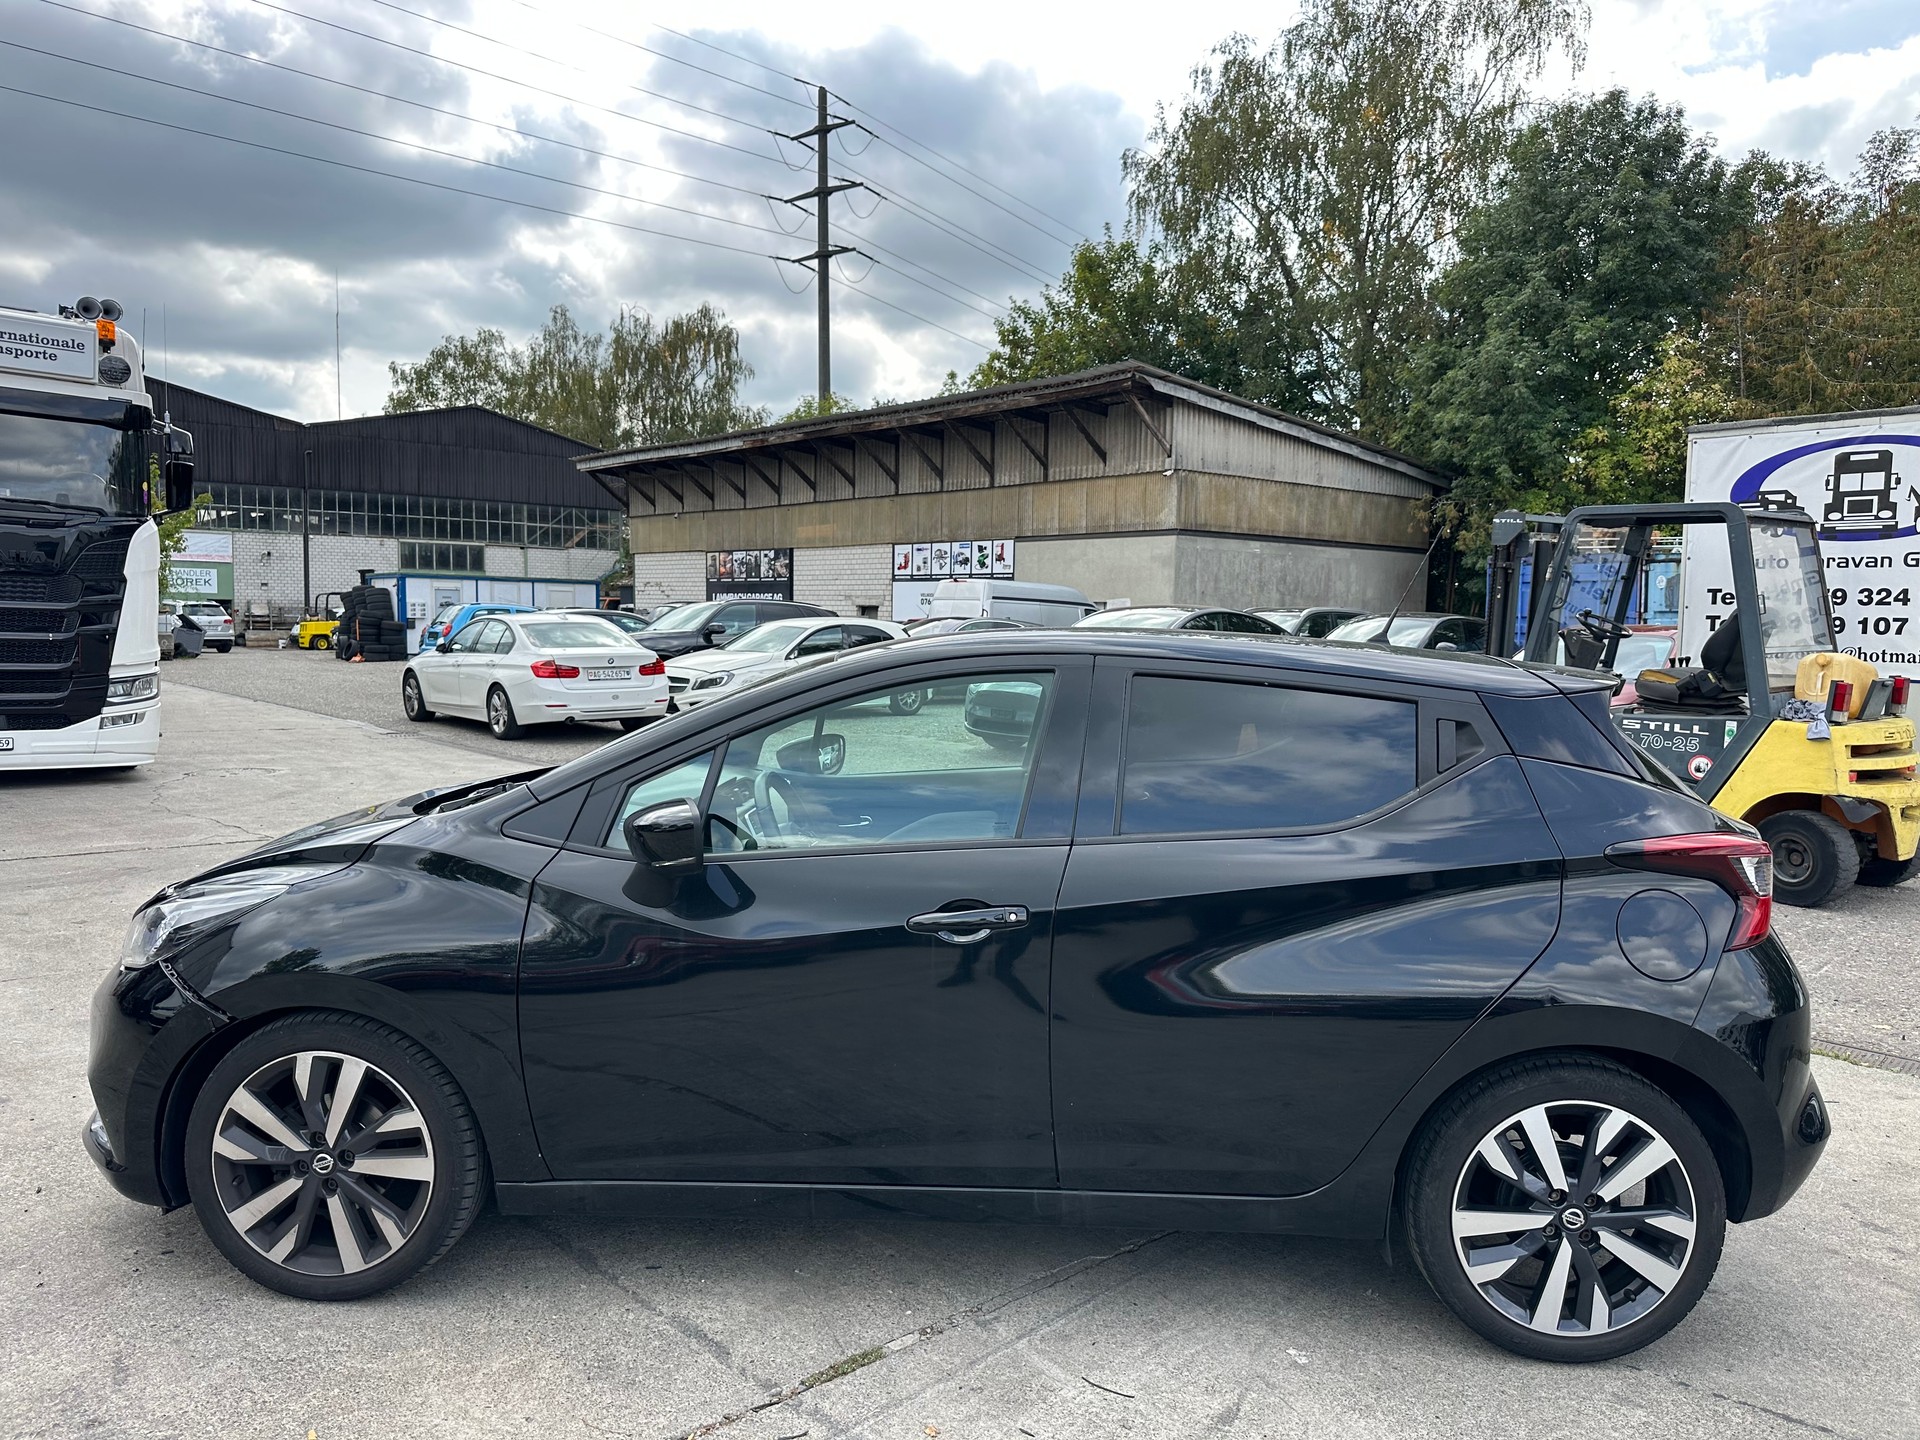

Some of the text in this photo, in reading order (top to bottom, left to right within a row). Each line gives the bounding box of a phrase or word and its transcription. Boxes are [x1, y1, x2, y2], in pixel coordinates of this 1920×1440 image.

[1755, 553, 1790, 570] uto
[1821, 555, 1893, 569] ravan
[1706, 588, 1736, 606] Te
[1857, 587, 1911, 606] 324
[1857, 616, 1909, 636] 107
[1622, 719, 1710, 736] STILL
[1639, 732, 1700, 752] 70-25
